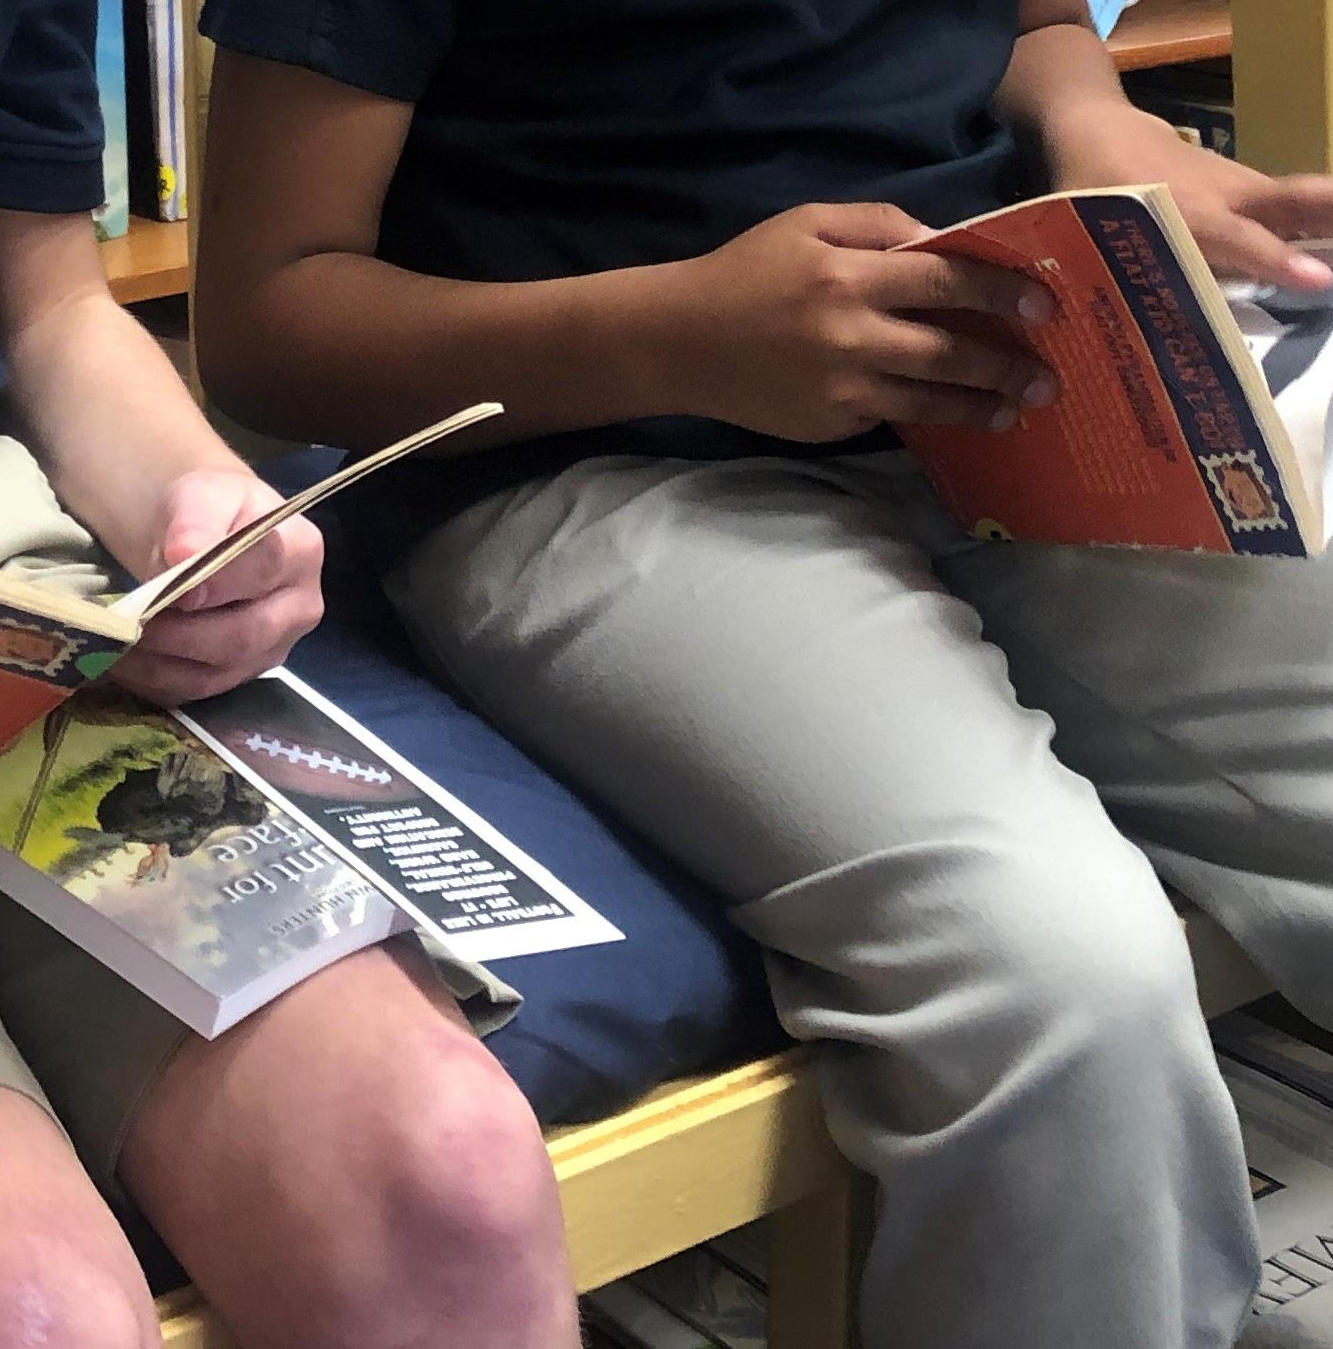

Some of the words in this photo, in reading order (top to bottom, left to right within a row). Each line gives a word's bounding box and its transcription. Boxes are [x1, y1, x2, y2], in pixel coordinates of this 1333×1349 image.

[1099, 219, 1120, 233] A
[1109, 239, 1152, 287] FLAT
[1139, 293, 1174, 333] KID
[222, 869, 279, 904] for
[270, 894, 345, 937] HUNTERS
